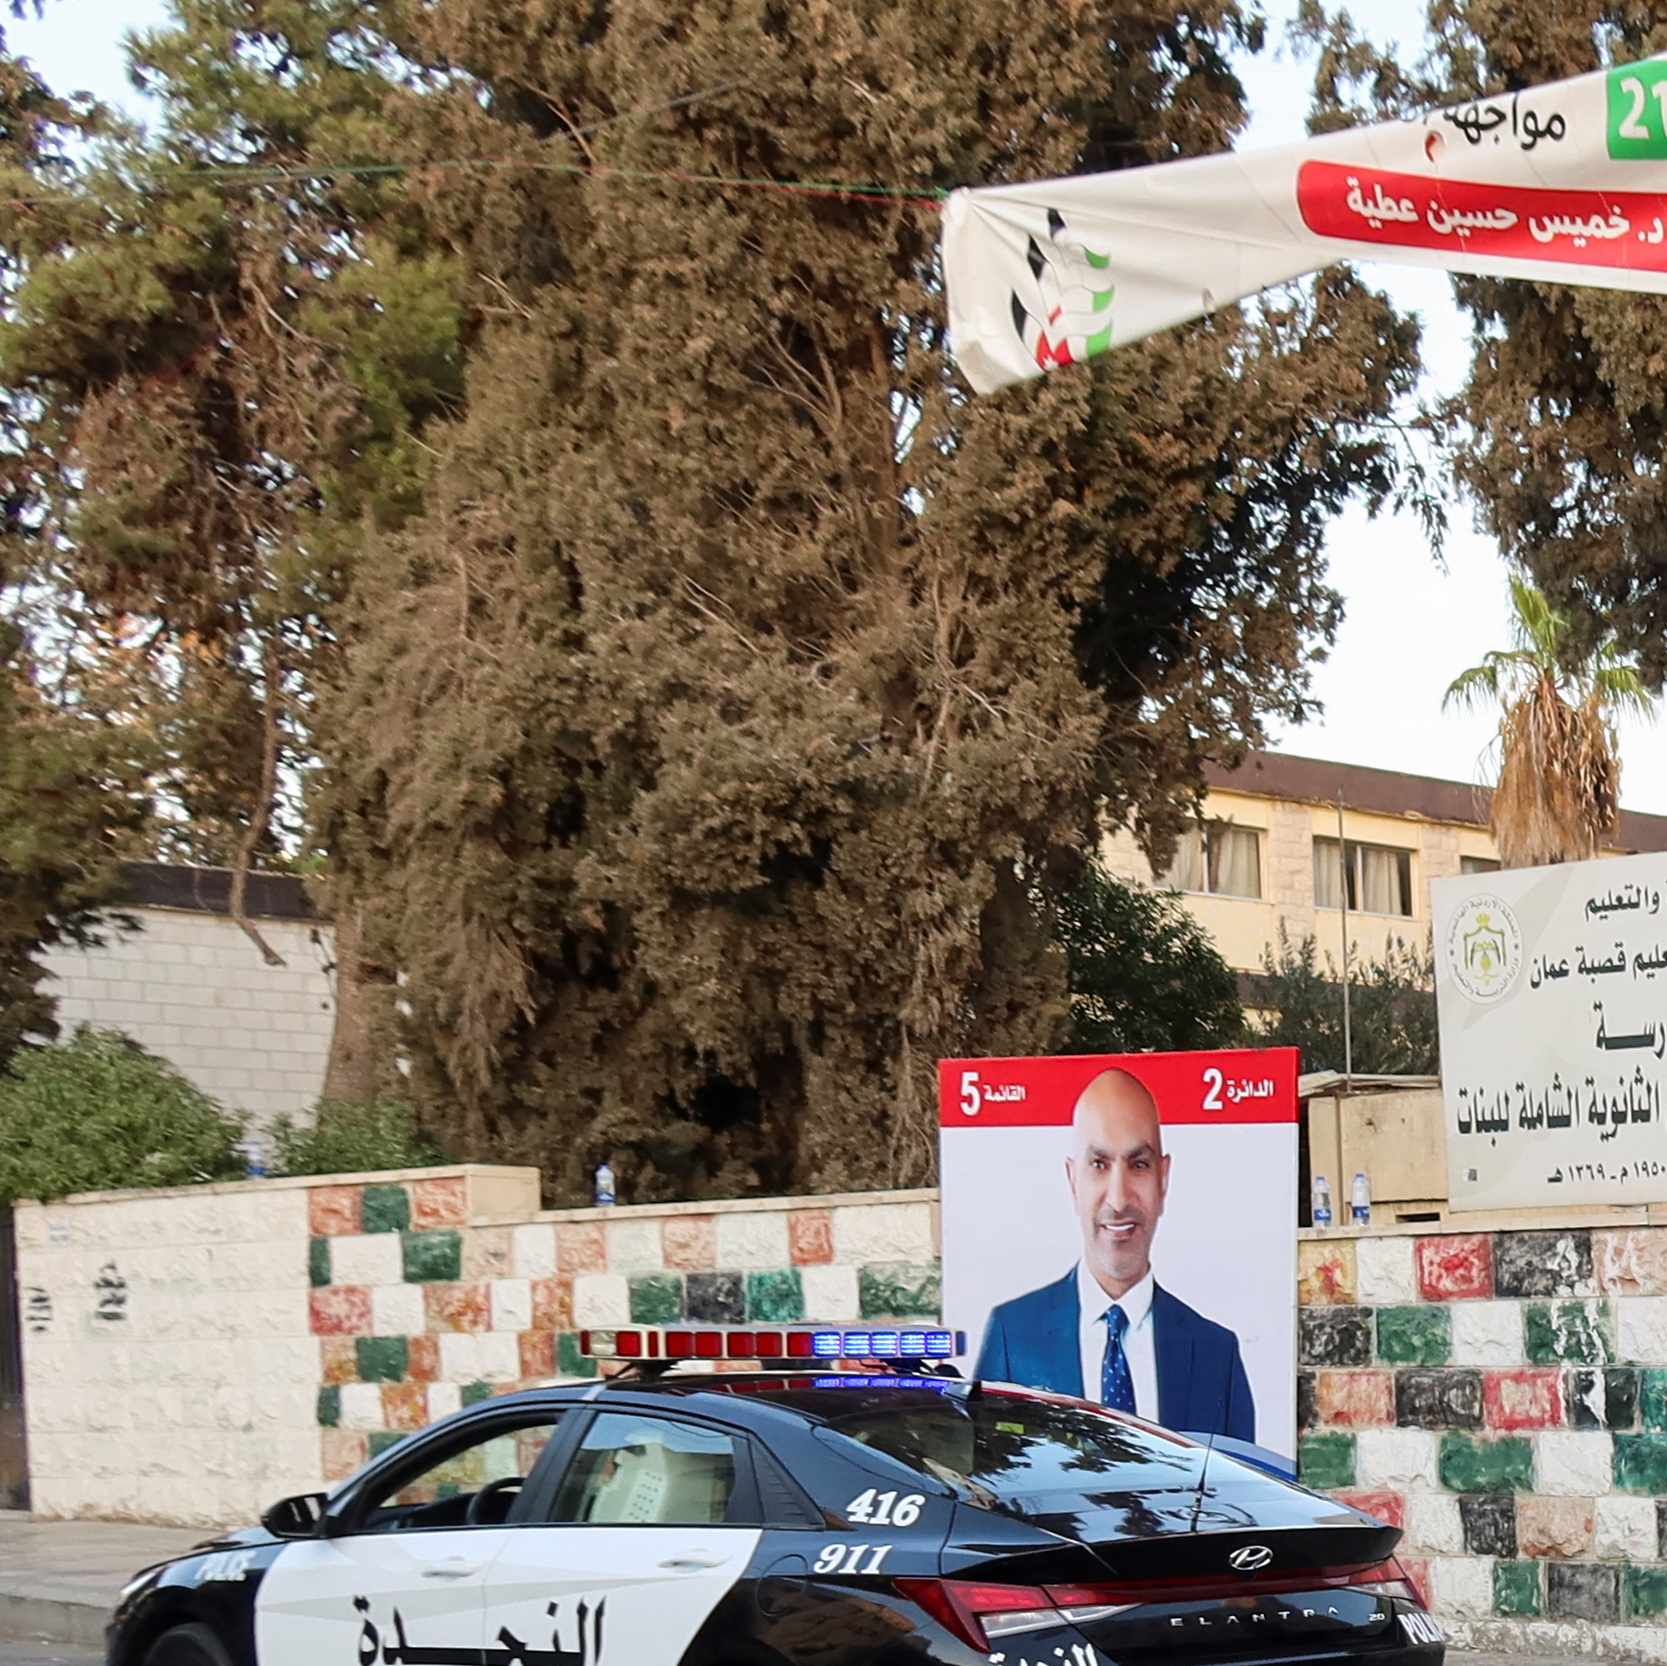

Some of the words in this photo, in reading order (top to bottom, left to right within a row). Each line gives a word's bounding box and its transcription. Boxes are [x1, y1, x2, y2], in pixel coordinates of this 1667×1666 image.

[1347, 176, 1417, 228] عطية
[1427, 196, 1518, 238] حسين
[1528, 205, 1631, 248] خميس
[1585, 884, 1660, 921] والتعليم
[1530, 954, 1570, 990] عمان
[1577, 942, 1627, 983] قصبة
[960, 1071, 982, 1116] 5
[983, 1083, 1026, 1102] القائمة
[1202, 1068, 1224, 1111] 2
[1226, 1078, 1275, 1104] الدائرة
[1515, 1071, 1581, 1132] الشاملة
[1586, 1066, 1661, 1143] الثانوية
[1456, 1086, 1511, 1149] للبنات
[1569, 1162, 1607, 1182] ١٣٦٩
[845, 1488, 926, 1527] 416
[812, 1543, 894, 1575] 911
[1170, 1606, 1340, 1627] ELANTRA
